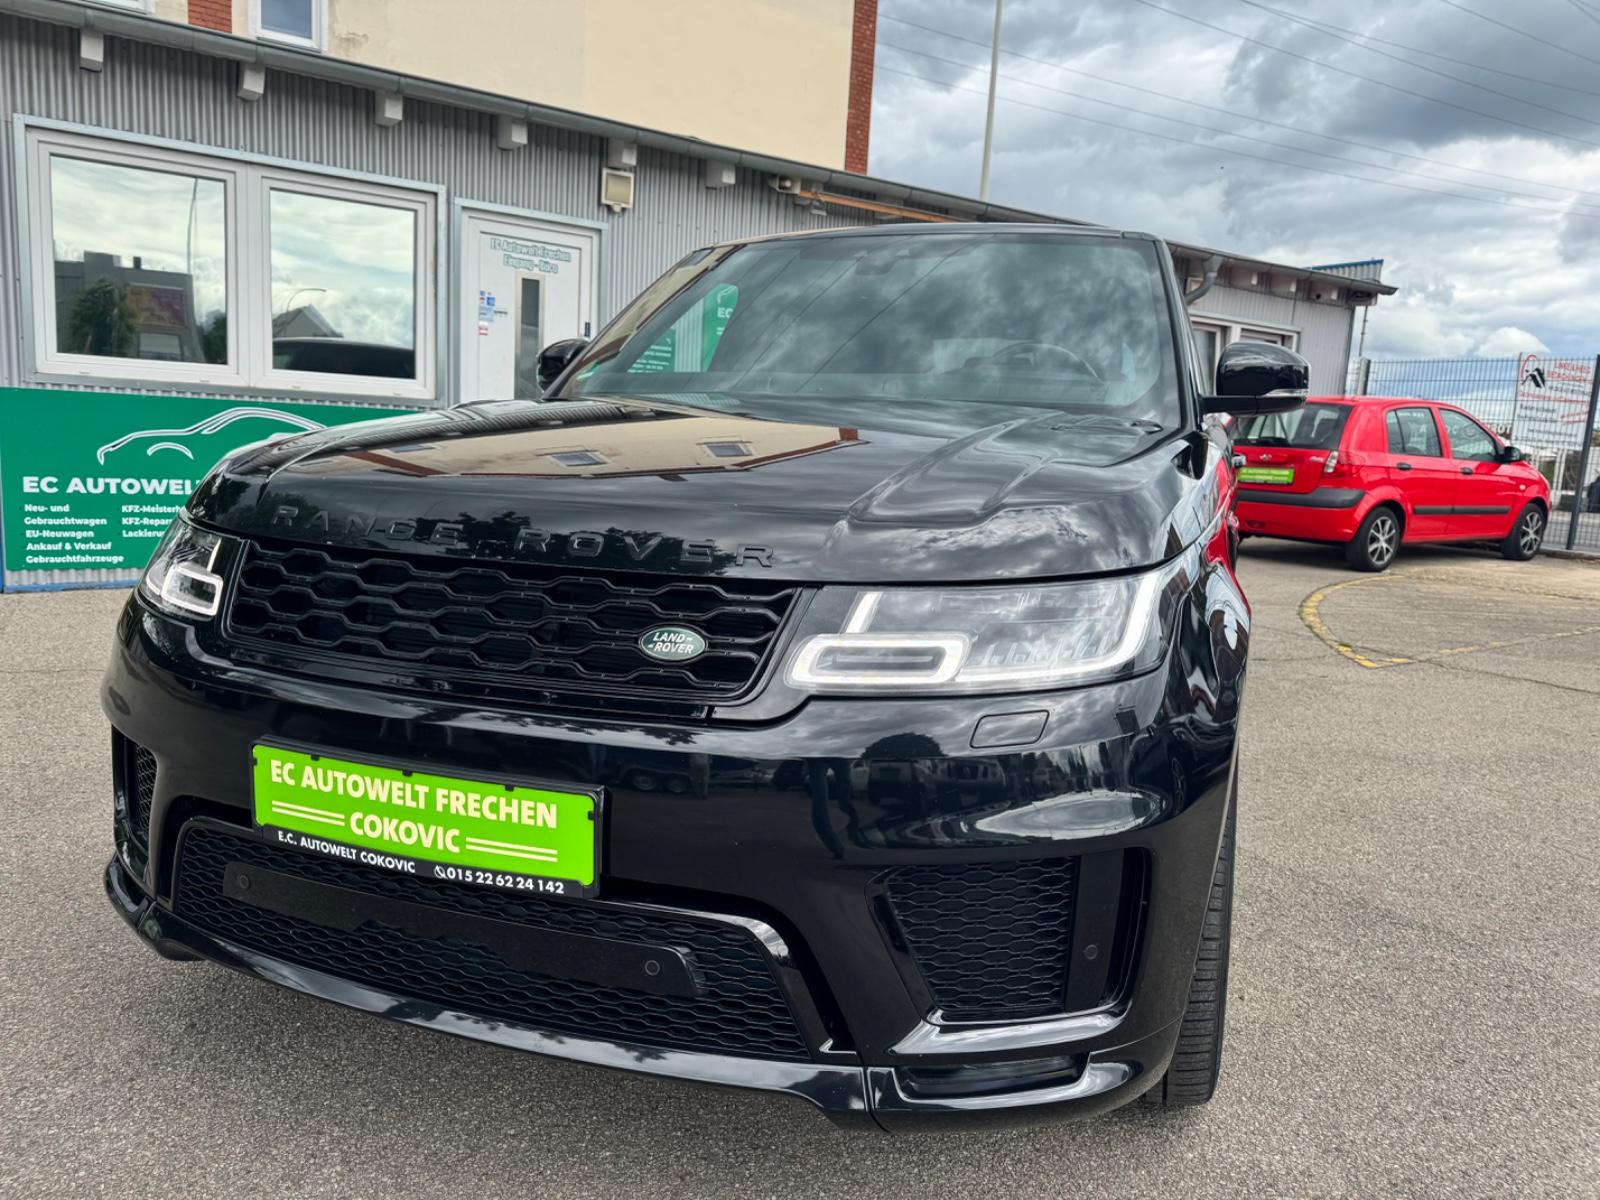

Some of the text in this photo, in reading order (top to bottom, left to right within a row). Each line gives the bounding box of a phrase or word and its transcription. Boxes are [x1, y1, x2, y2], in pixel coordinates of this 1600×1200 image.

[22, 475, 59, 494] EC
[24, 503, 70, 513] Neu- und
[121, 503, 182, 513] KFZ-Meisterh
[23, 516, 108, 528] Gebrauchtwagen
[121, 517, 172, 527] KFZ-Repar
[25, 529, 95, 540] EU-Neuwagen
[122, 529, 165, 538] Lackieru
[273, 505, 774, 568] RANGE ROVER
[26, 541, 112, 551] Ankauf & Verkauf
[25, 554, 124, 565] Gebrauchtfahrzeuge
[270, 759, 558, 829] EC AUTOWELT FRECHEN
[350, 812, 460, 853] COKOVIC
[277, 830, 298, 846] E.C.
[300, 837, 358, 860] AUTOWELT
[360, 851, 416, 874] COKOVIC
[475, 871, 494, 886] 22
[495, 874, 514, 888] 62
[516, 877, 535, 891] 24
[537, 879, 565, 895] 142
